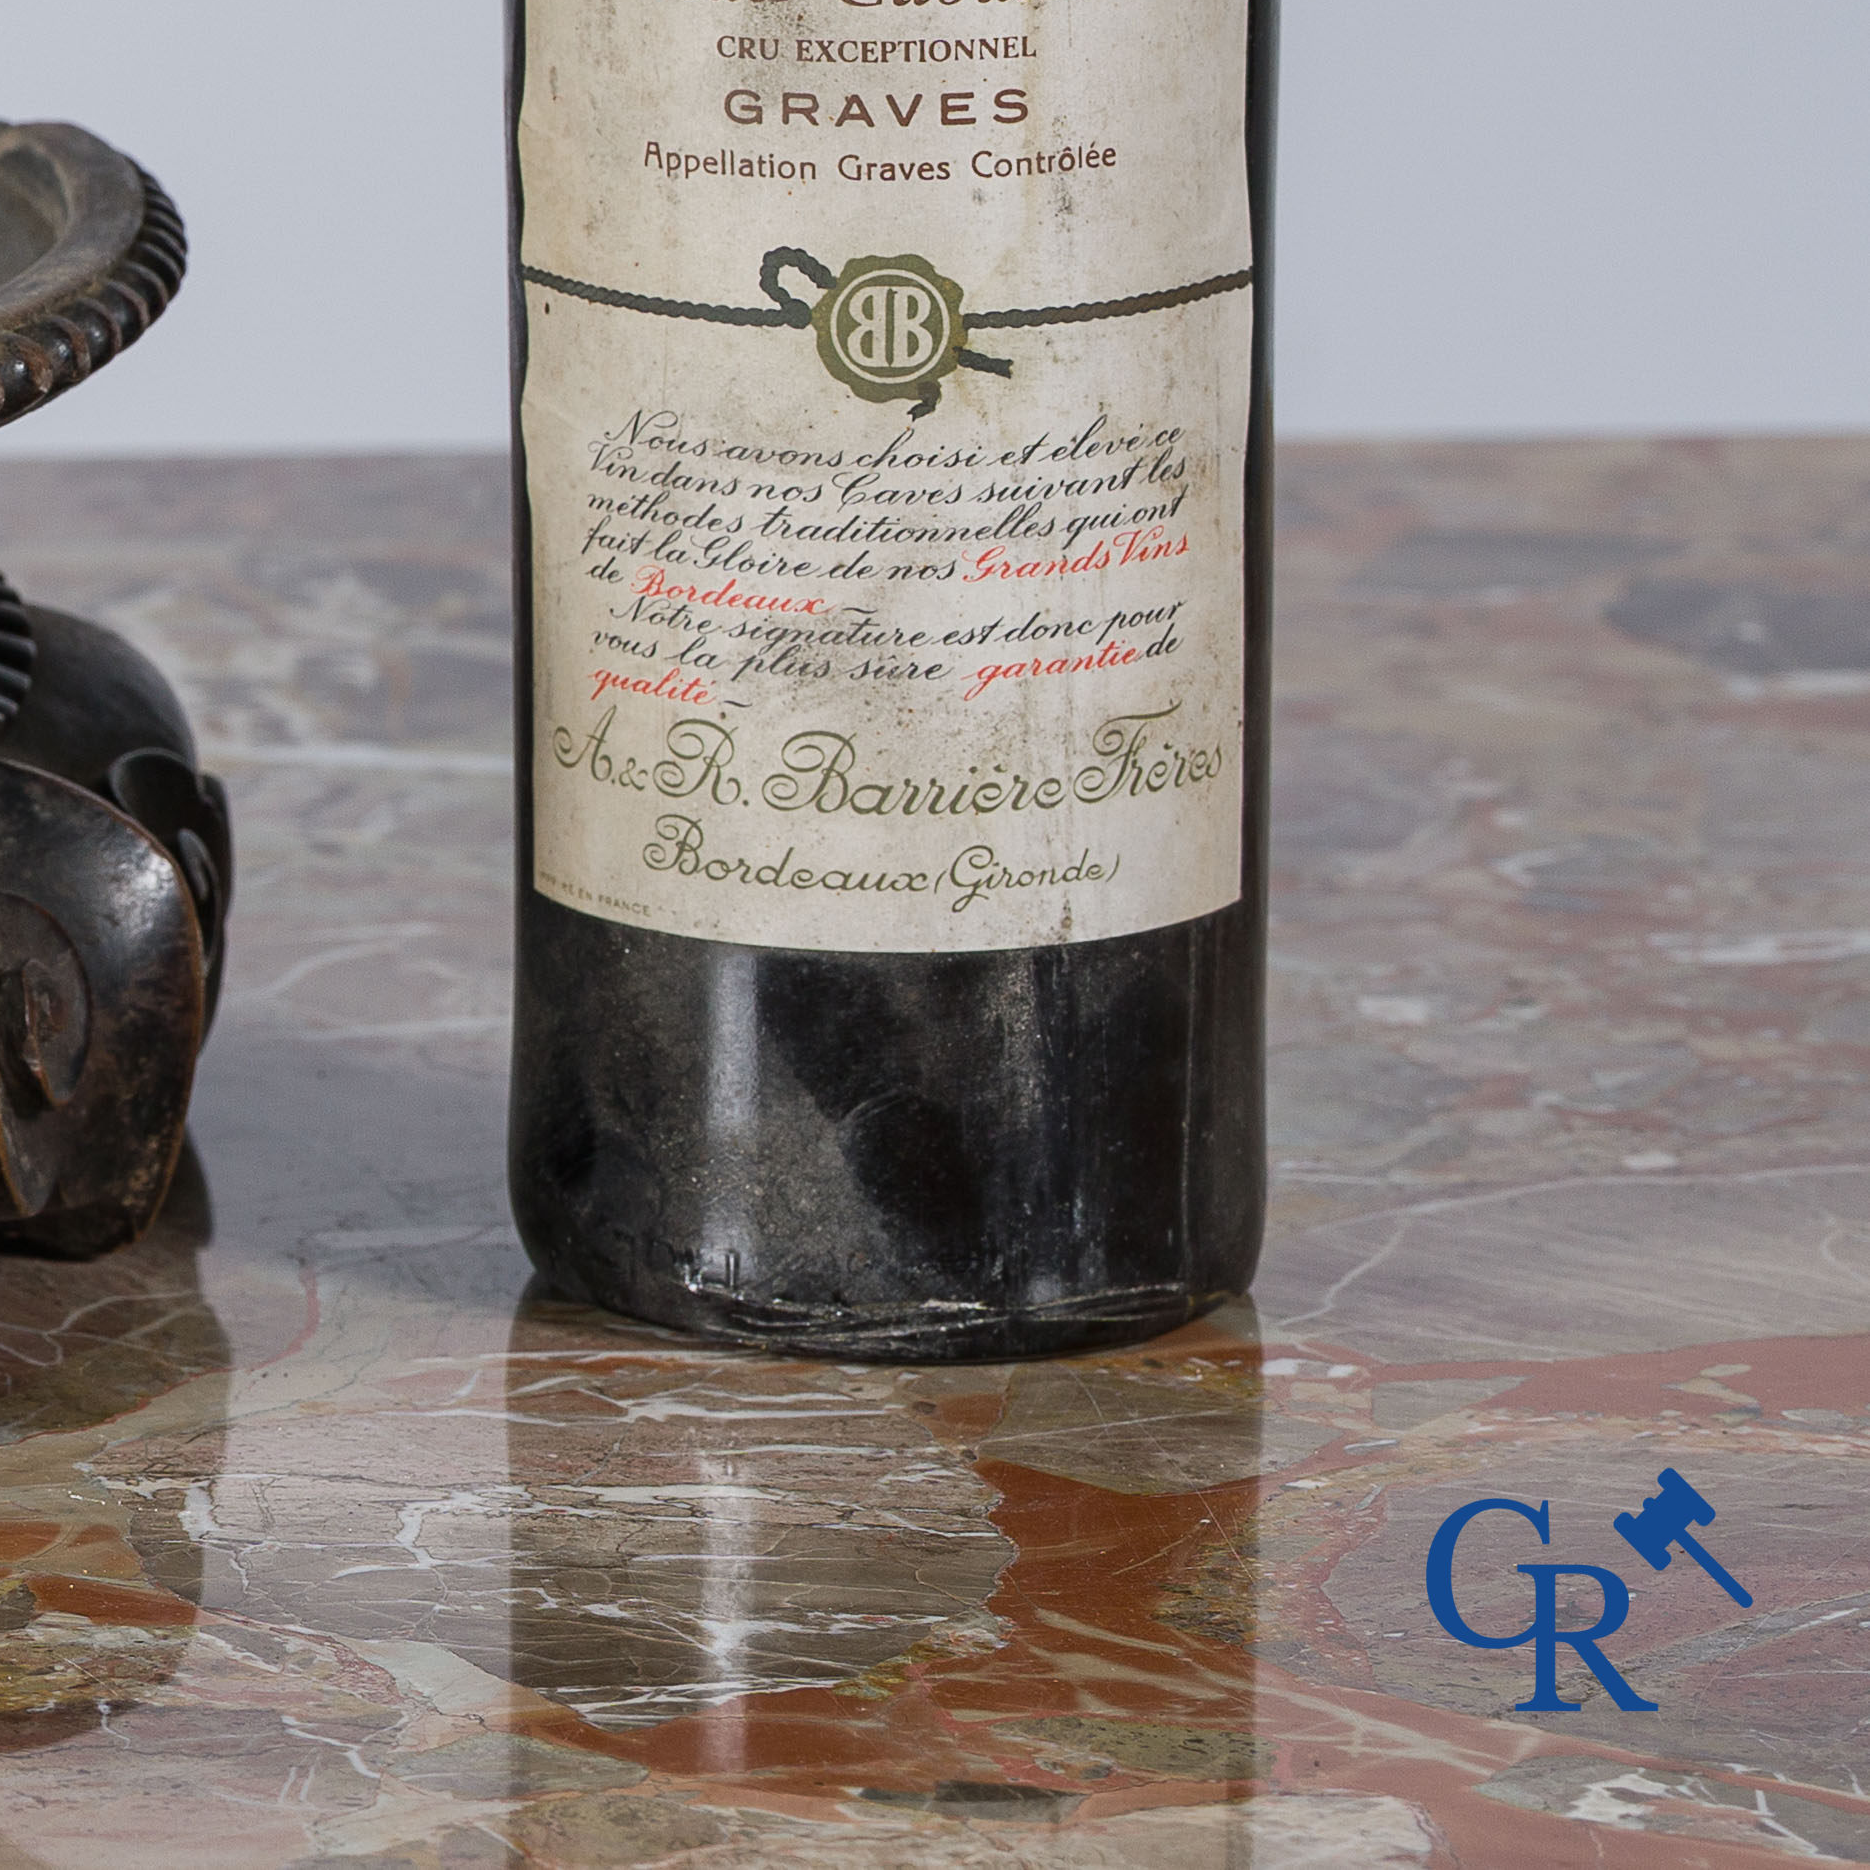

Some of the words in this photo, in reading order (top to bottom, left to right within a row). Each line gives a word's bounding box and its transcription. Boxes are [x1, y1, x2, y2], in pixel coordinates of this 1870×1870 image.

[716, 34, 781, 61] CRU
[796, 34, 1037, 63] EXCEPTIONNEL
[724, 88, 1030, 128] GRAVES
[643, 141, 817, 181] Appellation
[838, 154, 952, 181] Graves
[971, 142, 1118, 179] Contrôlée
[605, 408, 709, 457] Nous
[713, 440, 843, 468] avons
[855, 428, 986, 469] choisi
[987, 432, 1050, 466] et
[1152, 427, 1184, 445] ce
[587, 441, 648, 482] Vin
[650, 460, 740, 496] dans
[747, 478, 823, 503] nos
[832, 472, 963, 513] Caves
[968, 456, 1140, 503] suivant
[1137, 446, 1186, 485] les
[756, 500, 1058, 544] traditionnelles
[1062, 504, 1128, 549] qui
[1128, 483, 1189, 523] ont
[580, 516, 652, 555] fait
[650, 531, 690, 564] la
[690, 536, 821, 577] Gloire
[820, 550, 884, 580] de
[887, 558, 957, 580] nos
[962, 540, 1112, 583] Grands
[1113, 525, 1189, 566] Vins
[586, 556, 624, 584] de
[630, 564, 837, 616] Bordeaux
[610, 596, 722, 636] Notre
[727, 617, 934, 653] signature
[934, 616, 1005, 647] est
[993, 612, 1098, 644] donc
[1095, 599, 1189, 645] pour
[588, 667, 716, 707] qualité
[592, 629, 658, 659] vous
[665, 636, 728, 669] la
[732, 644, 832, 681] plus
[960, 638, 1140, 702] garantie
[1140, 623, 1185, 659] de
[761, 730, 1066, 816] Barrière
[1072, 698, 1222, 804] Frères
[642, 814, 928, 893] Bordeaux
[933, 845, 1121, 911] (Gironde)
[598, 894, 653, 918] FRANCE
